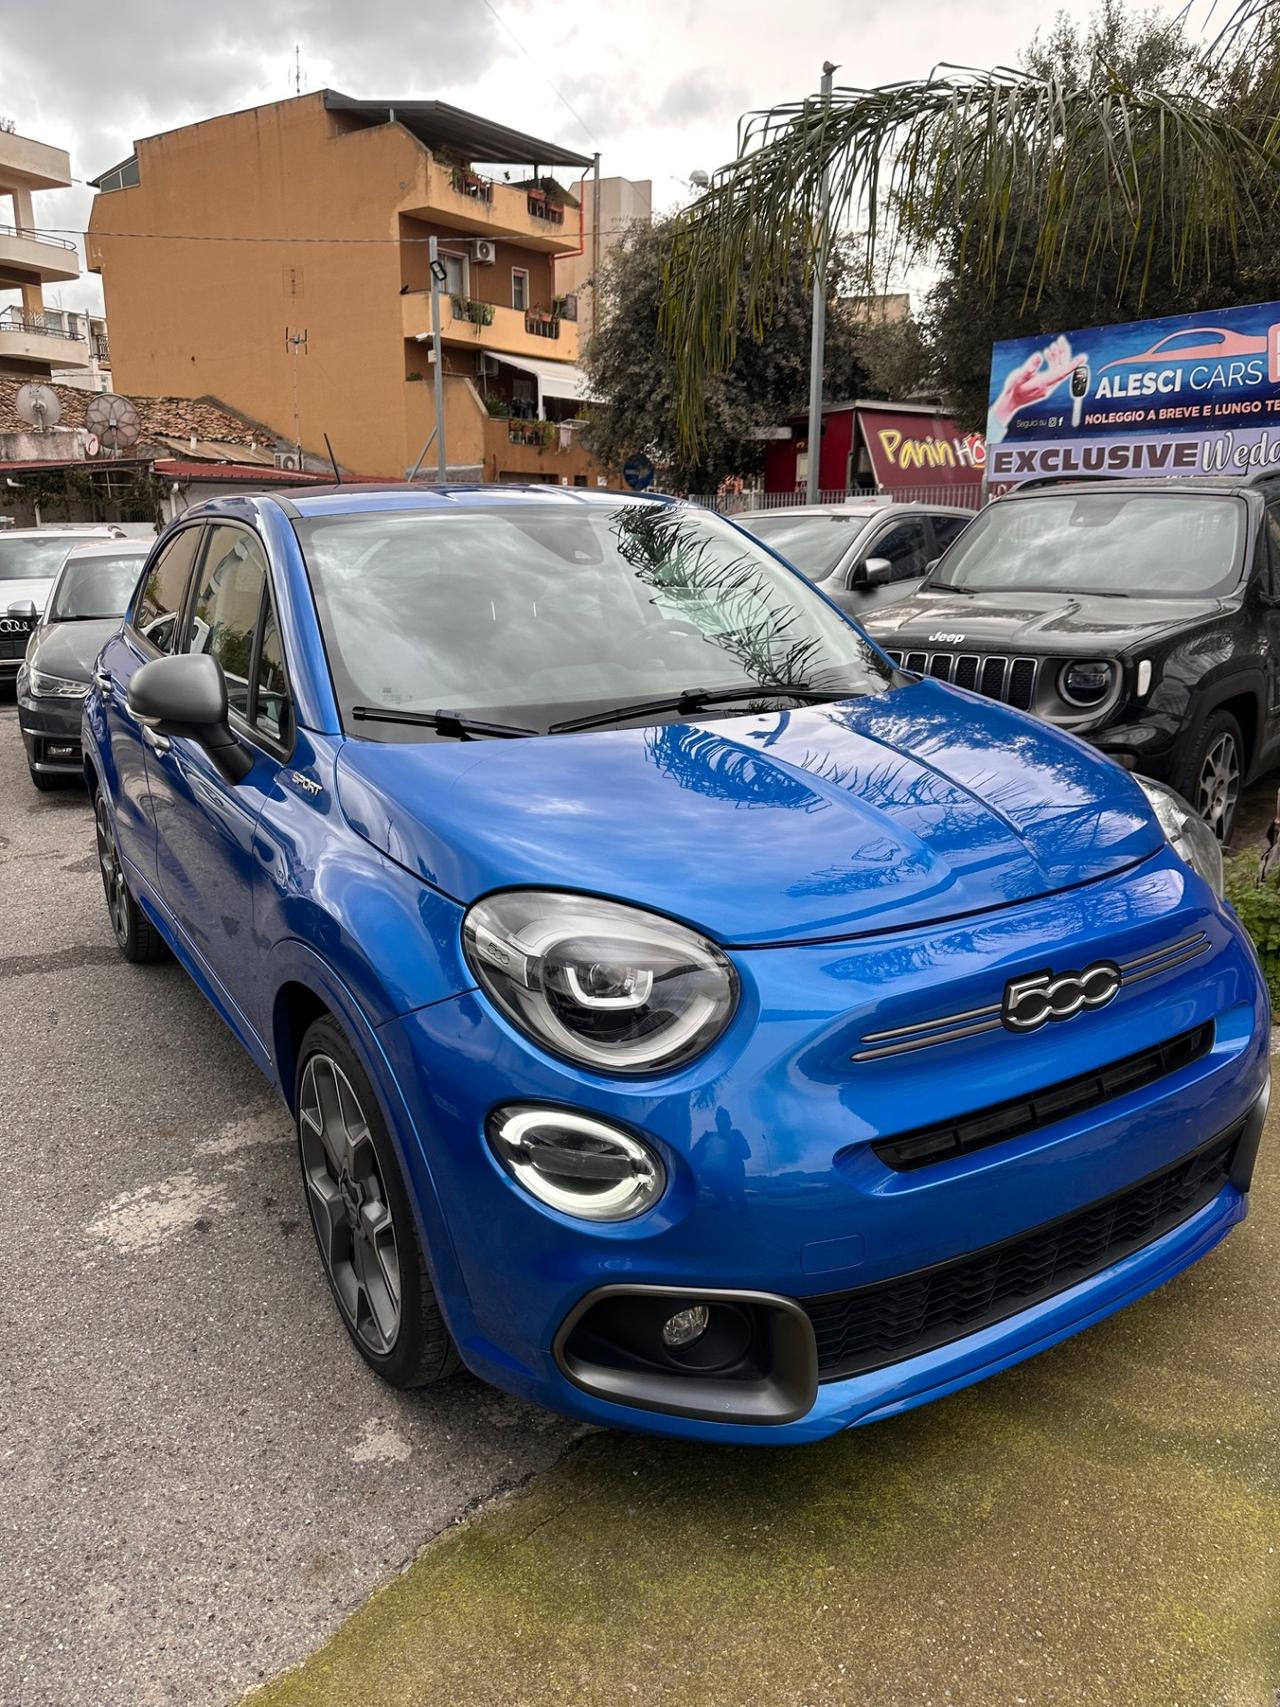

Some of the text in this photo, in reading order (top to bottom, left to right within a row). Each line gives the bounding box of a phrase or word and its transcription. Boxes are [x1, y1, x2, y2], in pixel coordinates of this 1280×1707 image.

[1095, 360, 1263, 399] ALESCI CARS
[1085, 410, 1145, 425] NOLEGGIO
[1147, 409, 1156, 421] A
[1159, 405, 1200, 420] BREVE
[1202, 404, 1212, 416] E
[1215, 401, 1262, 416] LUNGO
[993, 442, 1199, 474] EXCLUSIVE
[928, 631, 966, 644] Jeep
[292, 771, 323, 796] SPORT
[487, 942, 510, 965] 500
[1006, 967, 1119, 1027] 500
